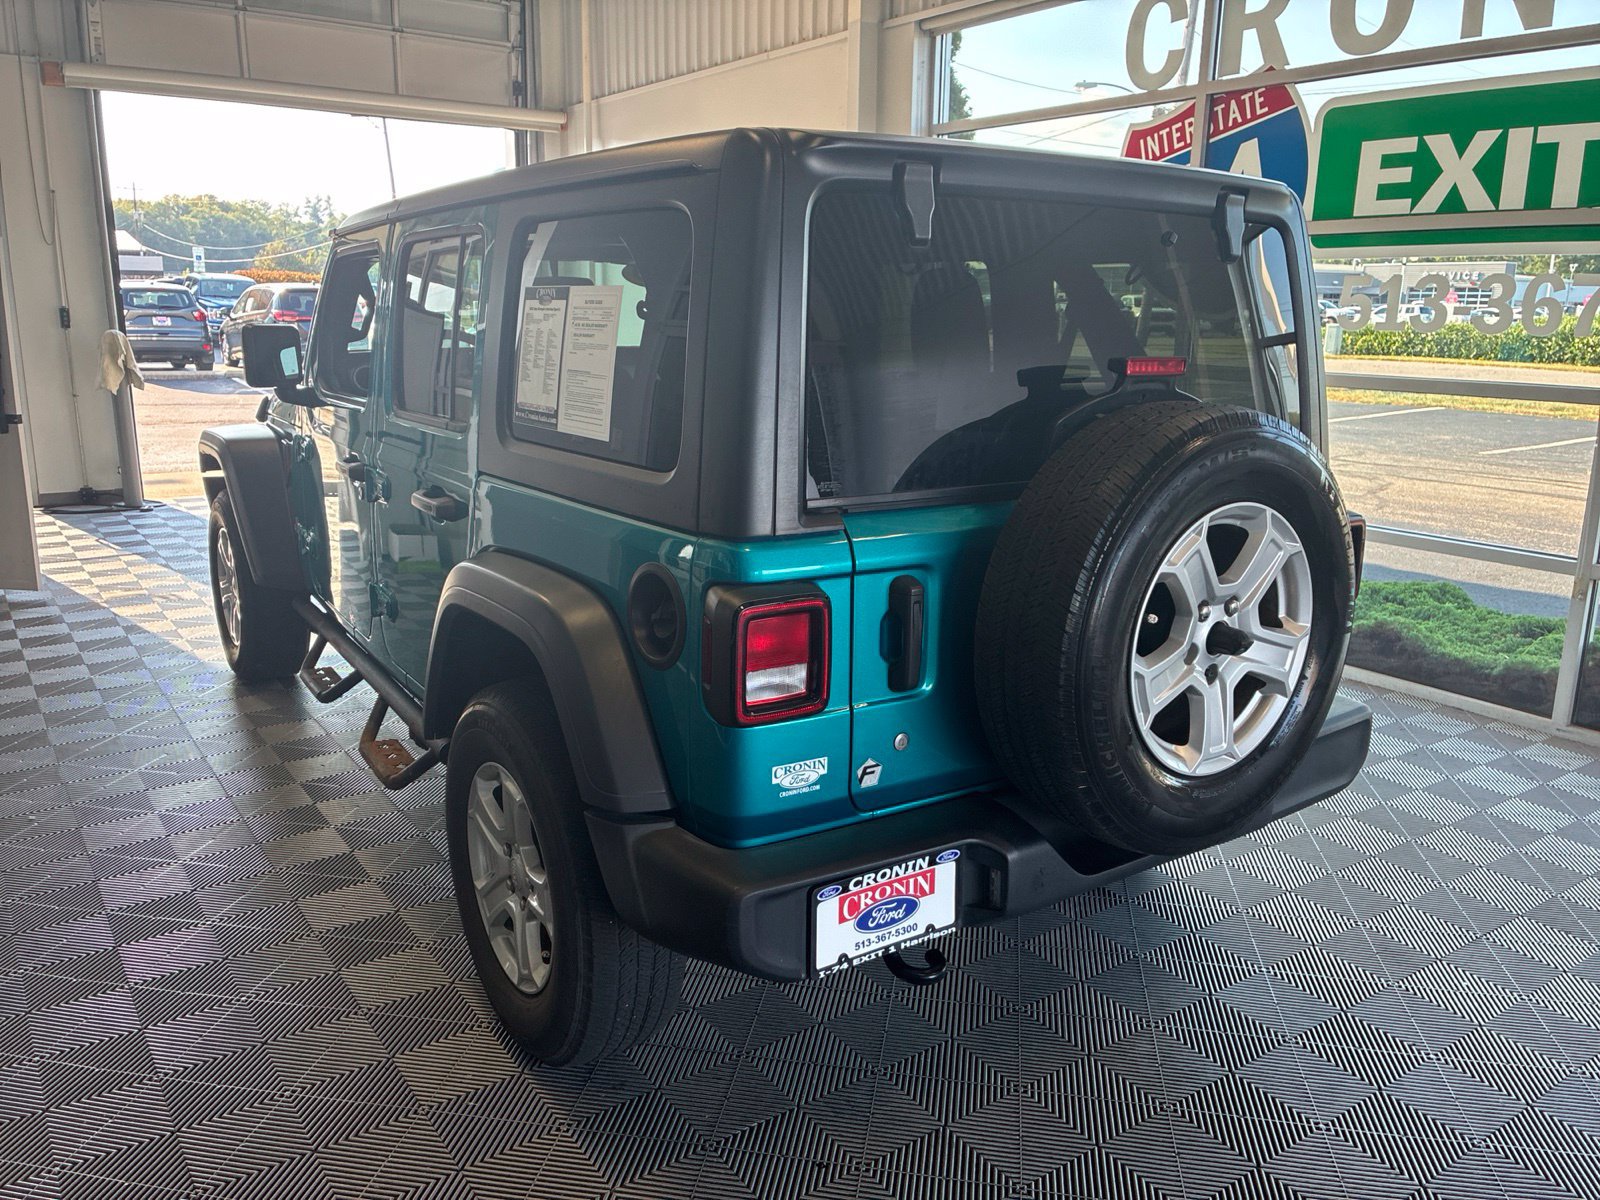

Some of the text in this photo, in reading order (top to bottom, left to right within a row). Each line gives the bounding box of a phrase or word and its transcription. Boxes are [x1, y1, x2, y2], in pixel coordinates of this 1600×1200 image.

[1140, 88, 1269, 160] INTERTATE
[1353, 122, 1600, 217] EXIT
[1422, 270, 1480, 281] VICE
[773, 758, 826, 780] CRONIN
[788, 773, 811, 786] Ford
[779, 785, 821, 798] CRONINFORD.COM
[848, 856, 930, 891] CRONIN
[842, 872, 932, 920] CRONIN
[868, 902, 908, 928] Ford
[854, 922, 918, 951] 513-367-5300
[818, 926, 957, 979] I-74 EXIT 1 Harrison
